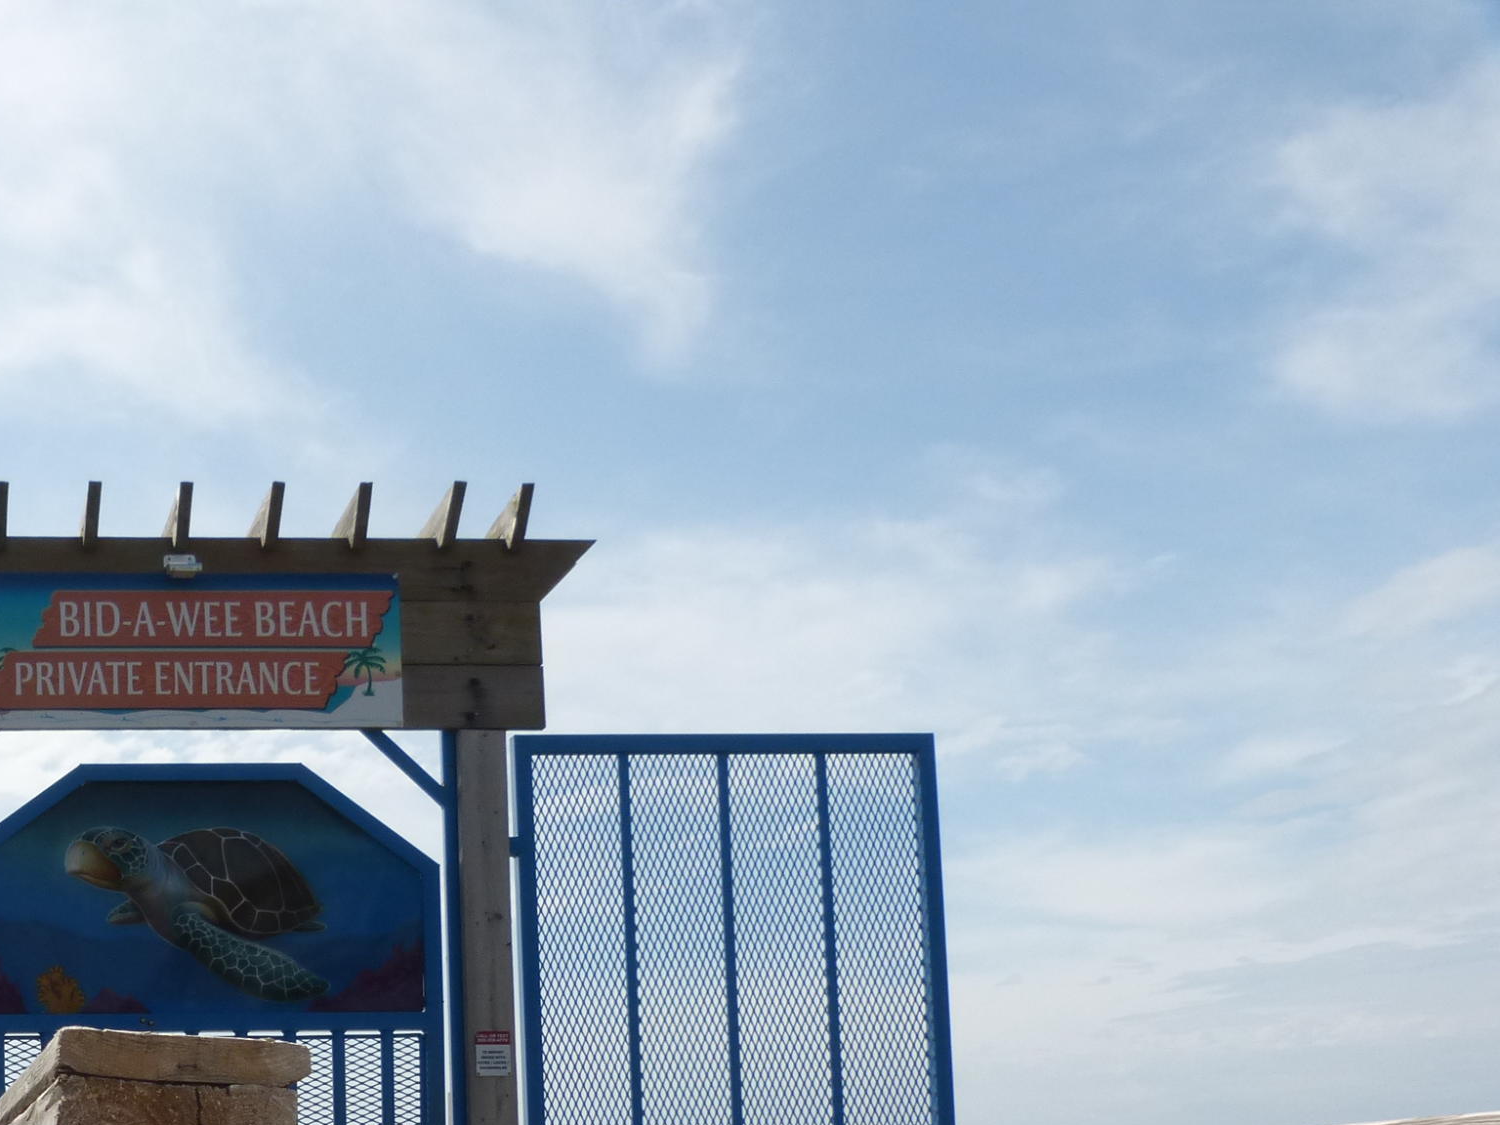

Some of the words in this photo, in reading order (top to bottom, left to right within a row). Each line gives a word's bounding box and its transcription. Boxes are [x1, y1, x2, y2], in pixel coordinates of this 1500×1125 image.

[58, 601, 243, 638] BID-A-WEE
[255, 600, 369, 638] BEACH
[14, 661, 144, 696] PRIVATE
[155, 661, 321, 696] ENTRANCE
